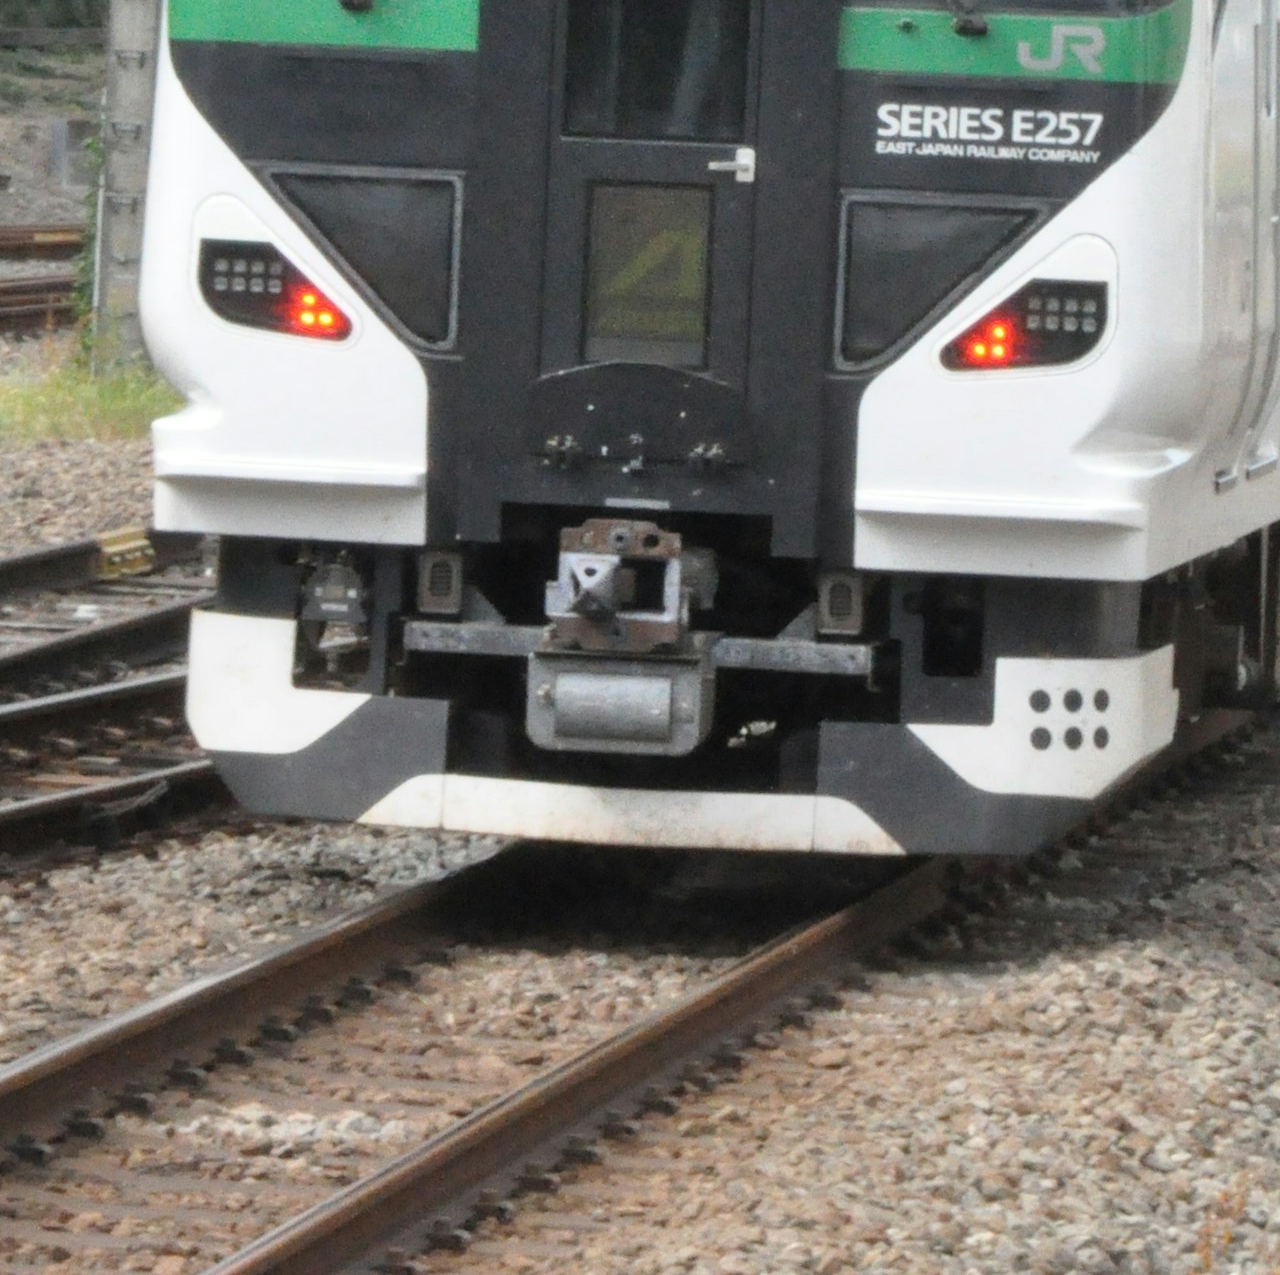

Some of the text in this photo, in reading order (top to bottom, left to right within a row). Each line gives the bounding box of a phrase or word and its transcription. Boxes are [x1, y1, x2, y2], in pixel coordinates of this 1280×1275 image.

[1017, 24, 1106, 73] JR
[876, 103, 1103, 146] SERIES E257
[875, 141, 1101, 163] EAST JAPAN RAILWAY COMPANY
